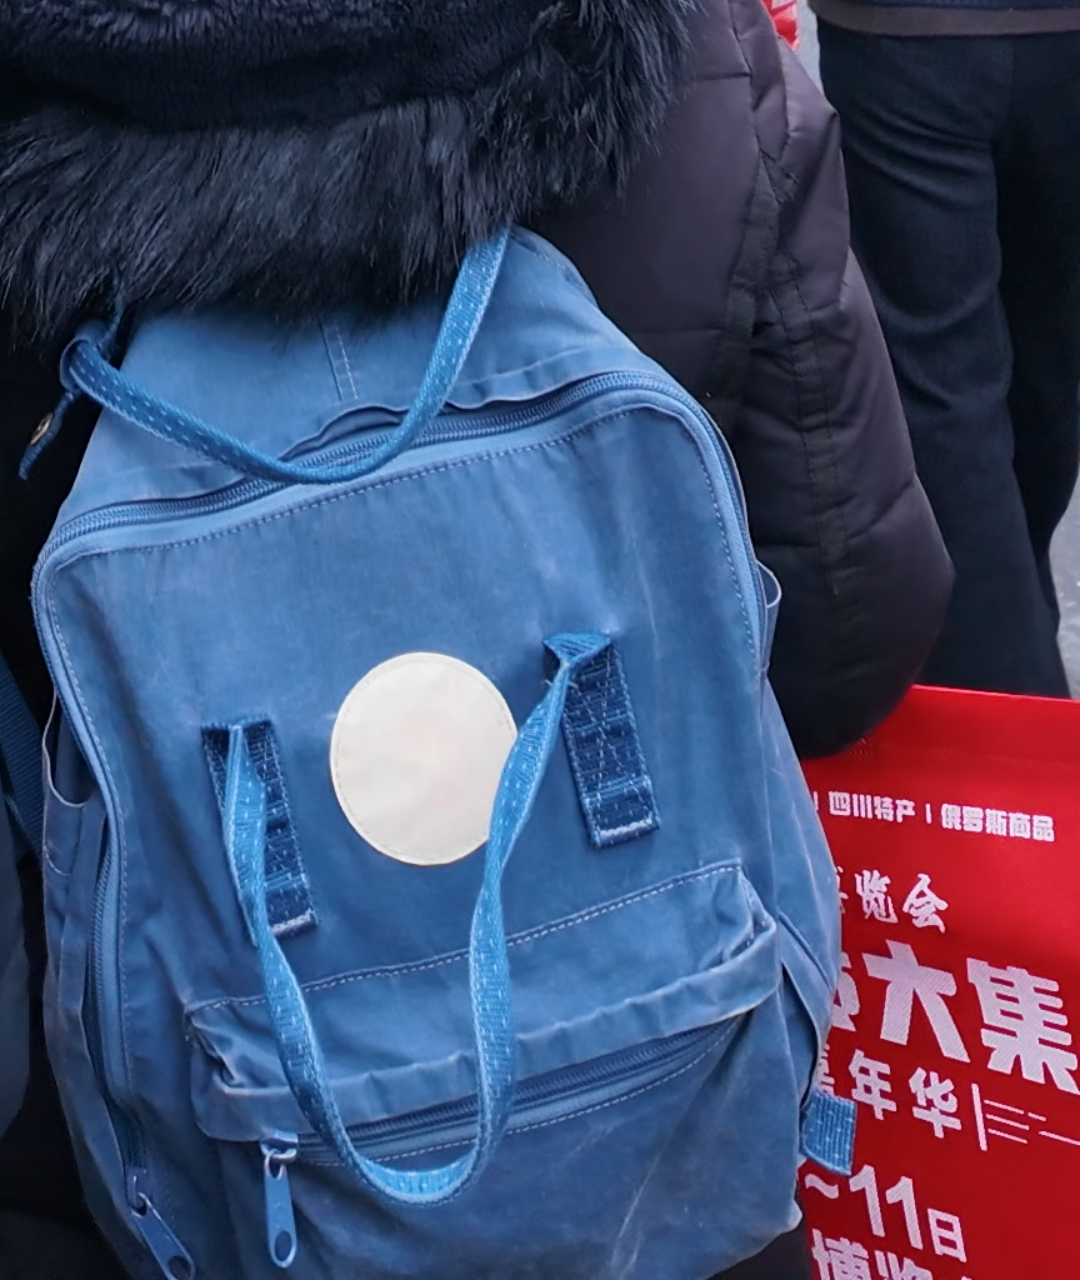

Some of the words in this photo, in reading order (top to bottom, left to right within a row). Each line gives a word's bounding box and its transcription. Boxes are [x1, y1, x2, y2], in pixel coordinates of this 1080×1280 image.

[828, 791, 916, 823] 四川特产
[941, 803, 1055, 842] 俄罗斯商品
[836, 866, 949, 934] 览会
